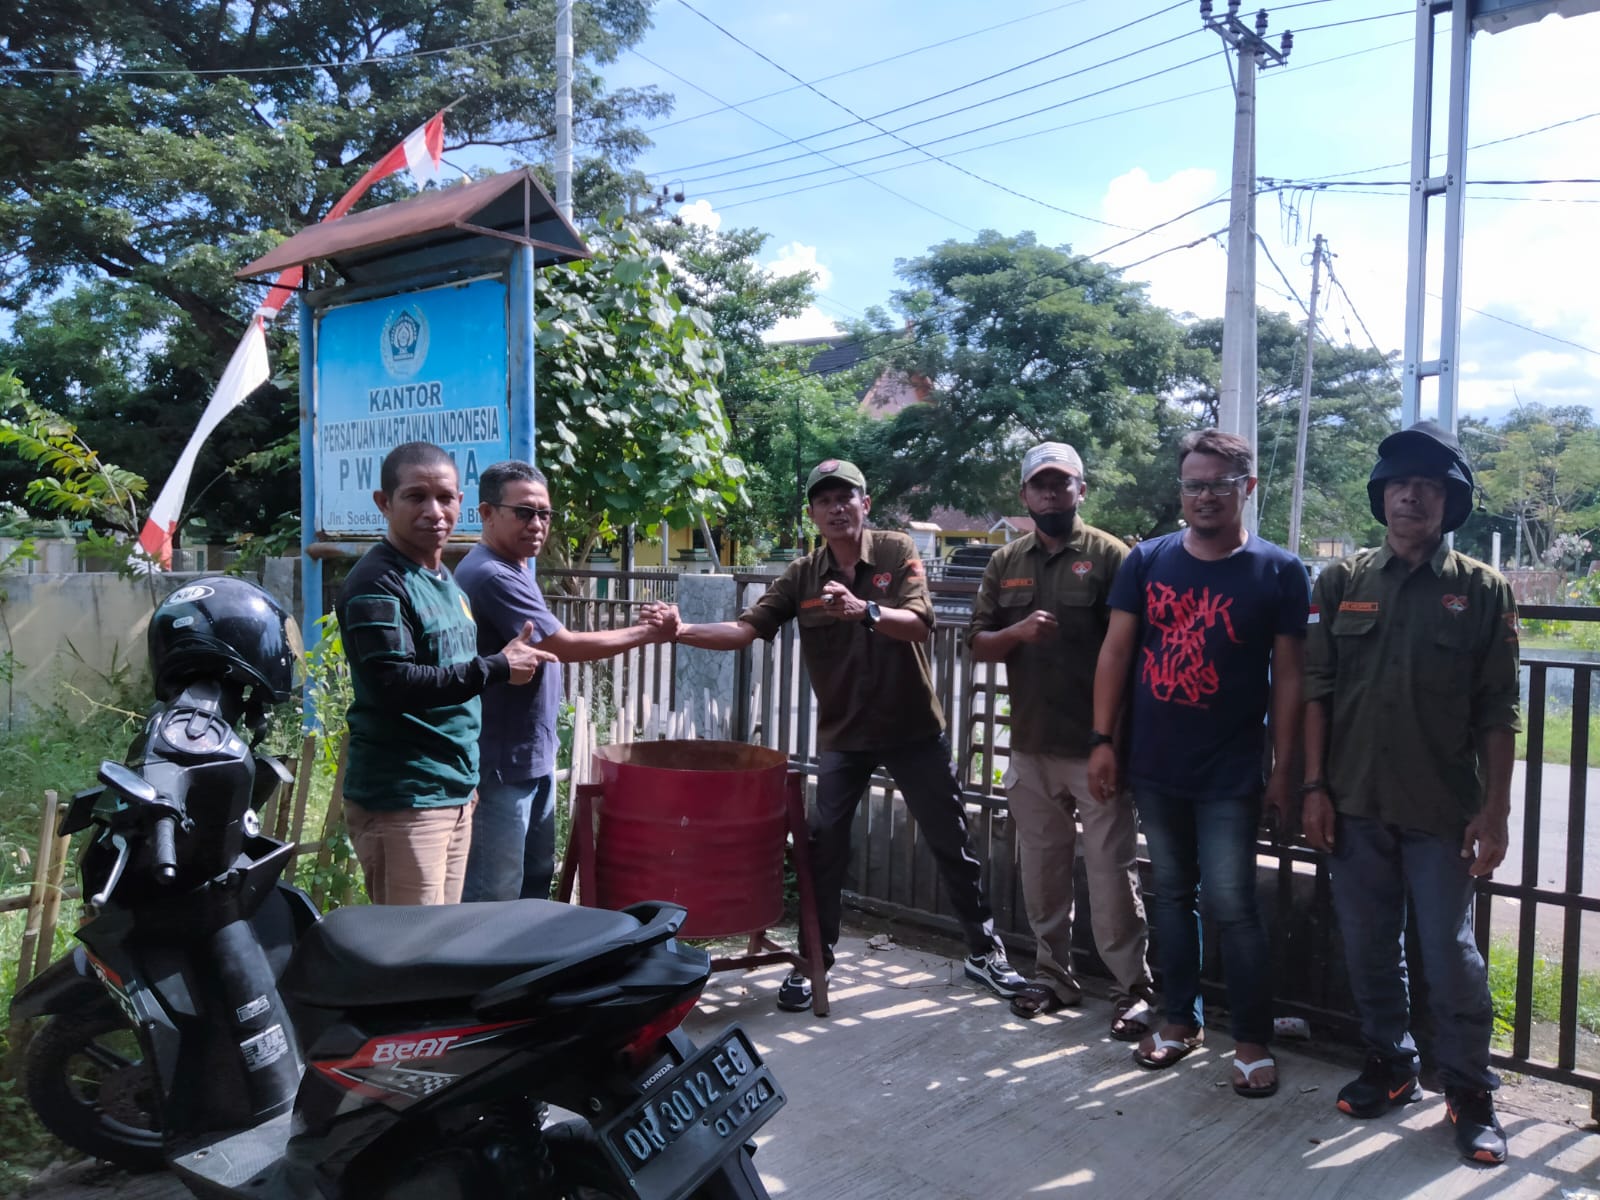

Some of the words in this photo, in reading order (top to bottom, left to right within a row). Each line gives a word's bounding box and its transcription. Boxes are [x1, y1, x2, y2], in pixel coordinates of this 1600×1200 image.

[369, 382, 442, 412] KANTOR
[324, 418, 376, 451] PERSATUAN
[378, 413, 435, 448] WARTAWAN
[439, 407, 499, 442] INDONESIA
[641, 1063, 675, 1090] HONDA
[660, 1071, 720, 1132] 3012
[712, 1045, 747, 1086] EC
